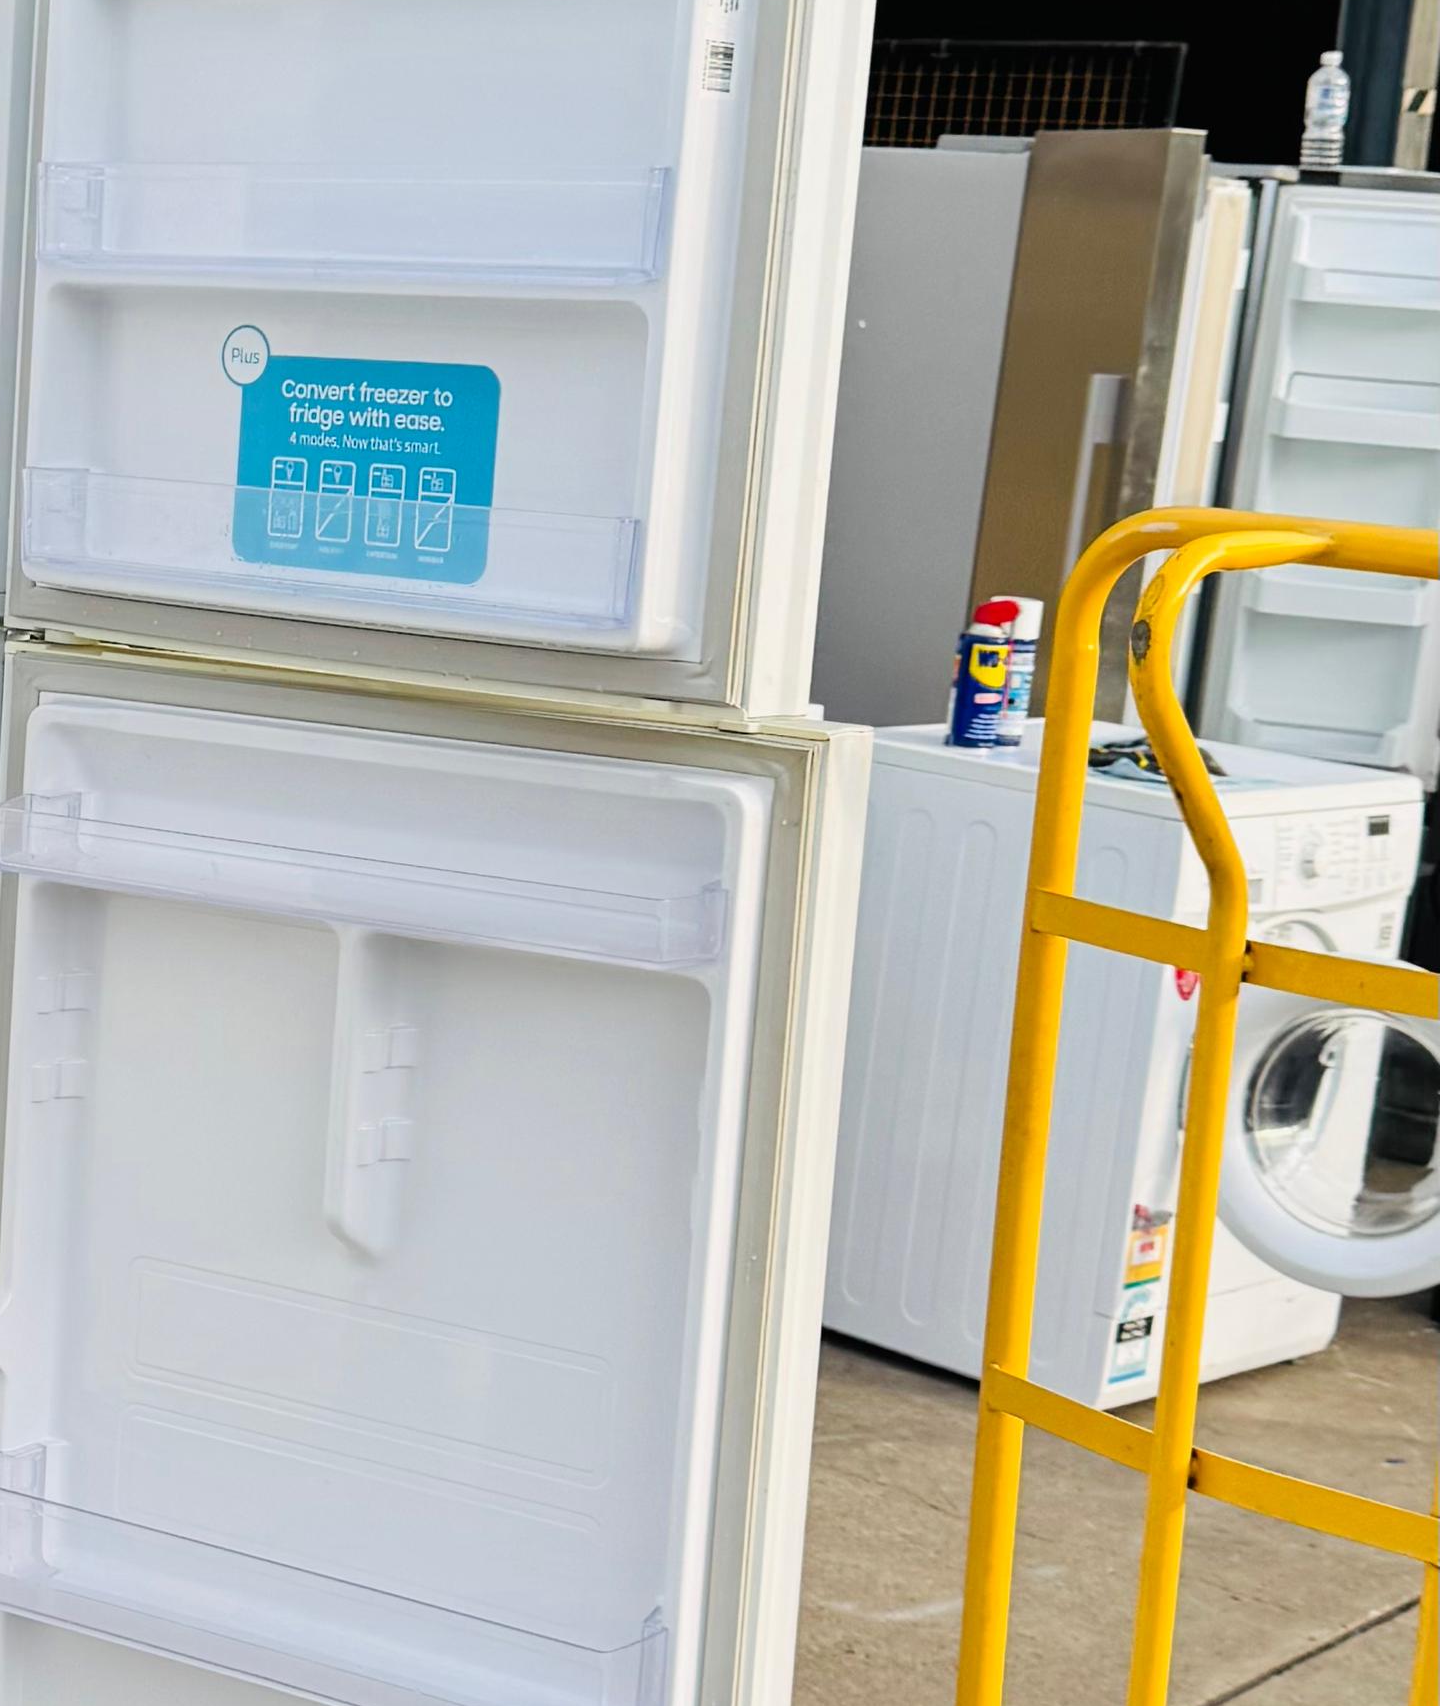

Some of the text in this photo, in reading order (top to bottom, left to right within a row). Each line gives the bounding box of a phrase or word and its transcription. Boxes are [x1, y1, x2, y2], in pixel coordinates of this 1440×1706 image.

[231, 347, 260, 365] Plus
[281, 379, 453, 407] Convert freezer to
[289, 402, 445, 432] fridge with ease.
[289, 431, 297, 445] 4
[342, 435, 369, 450] Now
[370, 436, 403, 453] that's
[404, 439, 441, 455] smart.
